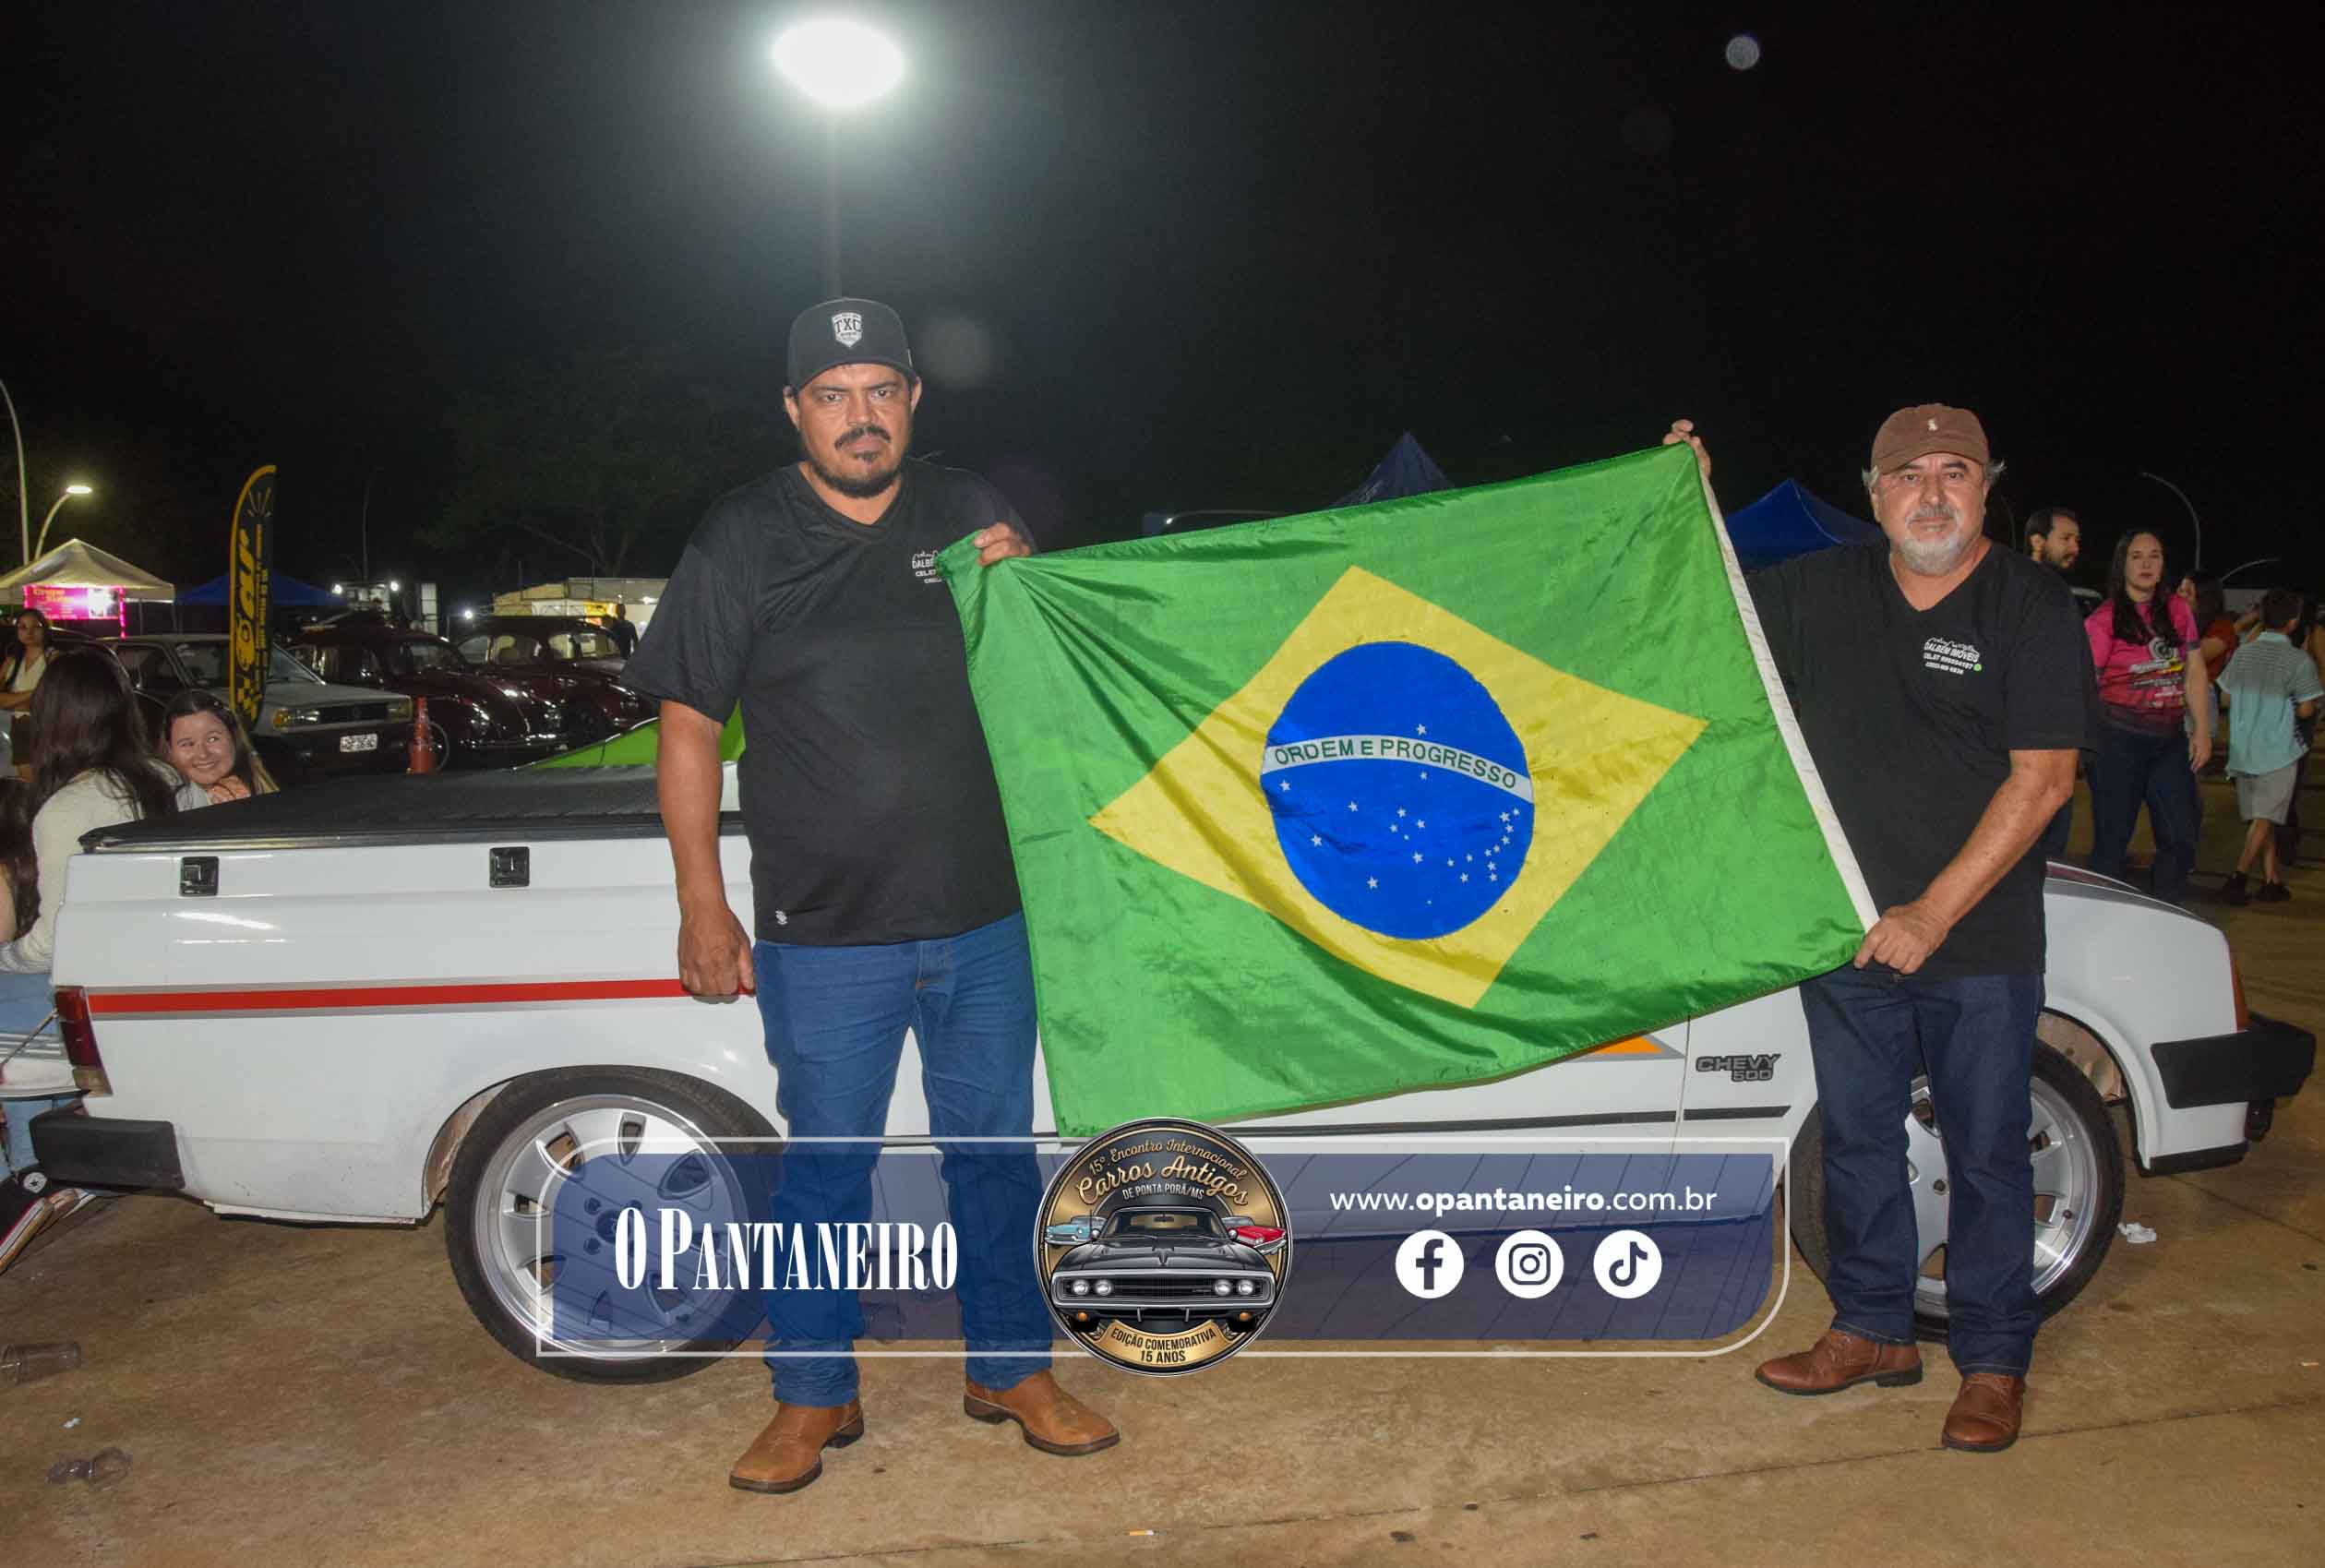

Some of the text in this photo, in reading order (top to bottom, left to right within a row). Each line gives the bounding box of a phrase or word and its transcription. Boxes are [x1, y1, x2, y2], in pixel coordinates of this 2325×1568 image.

[1274, 738, 1517, 790] ORDEM E PROGRESSO
[1696, 1053, 1781, 1071] CHEVY
